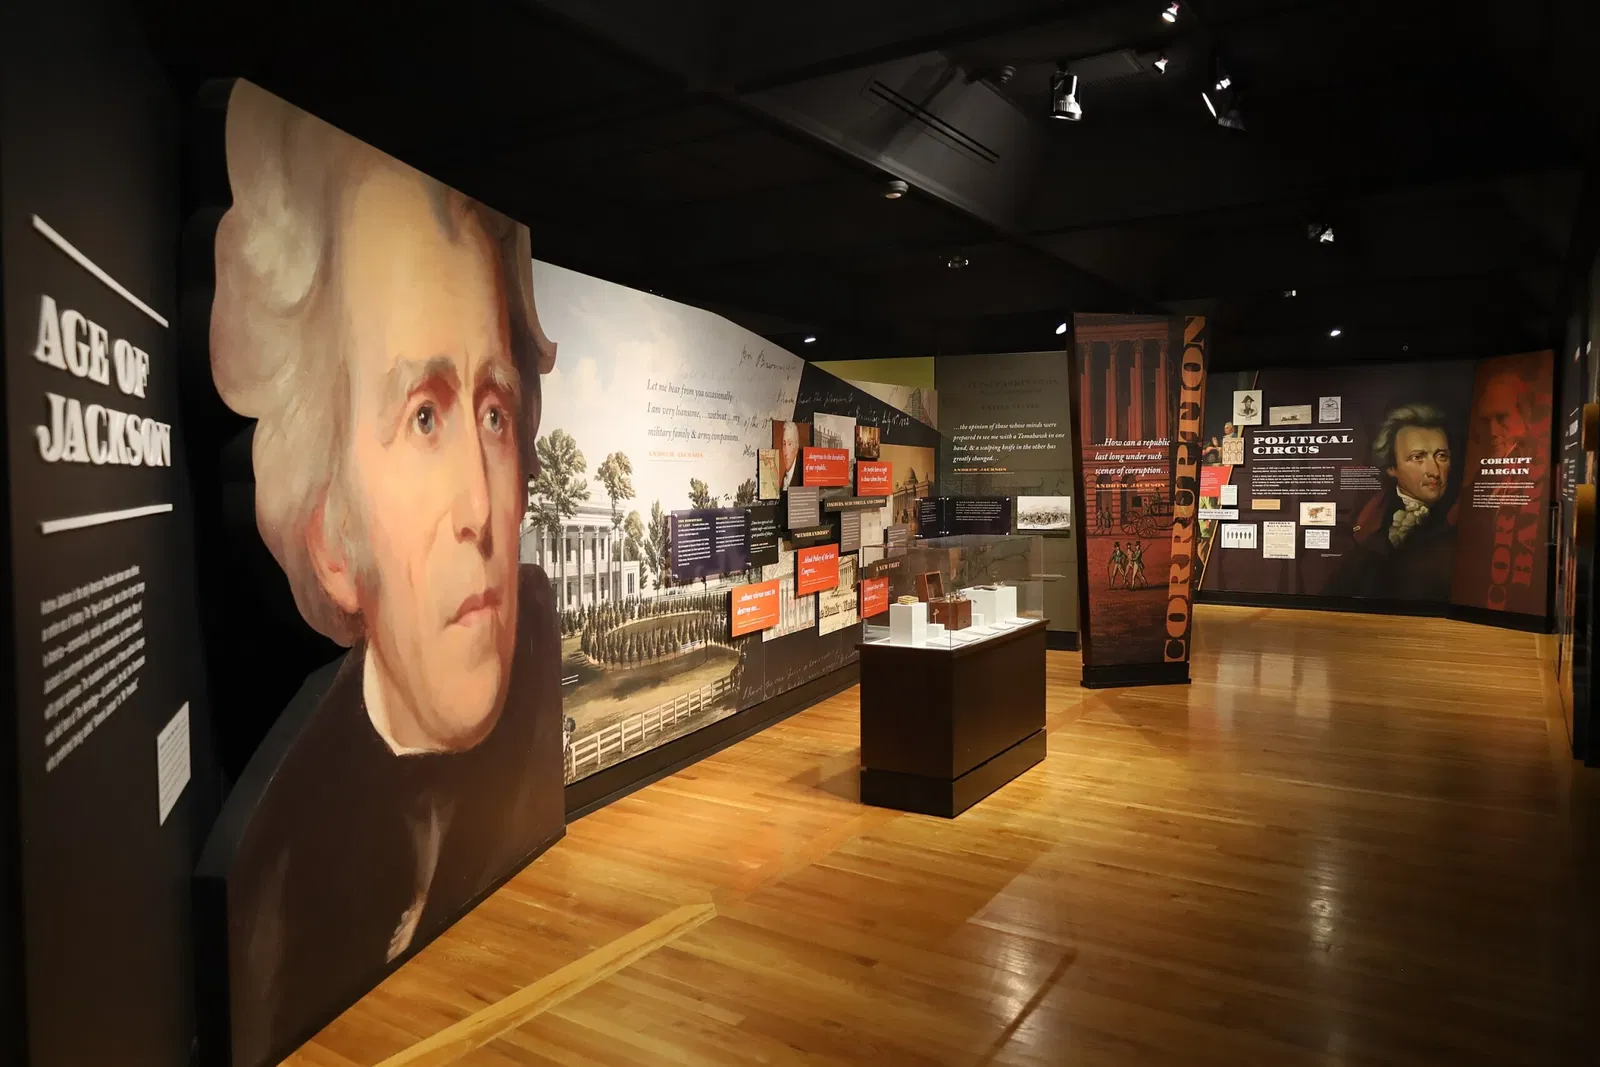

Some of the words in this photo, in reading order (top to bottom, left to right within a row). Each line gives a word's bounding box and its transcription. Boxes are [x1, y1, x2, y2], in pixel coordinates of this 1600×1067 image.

[33, 294, 110, 385] AGE
[113, 338, 149, 399] OF
[646, 379, 658, 391] Let
[659, 384, 669, 393] me
[668, 382, 681, 394] hear
[680, 384, 695, 398] from
[695, 389, 706, 400] you
[647, 402, 651, 413] I
[662, 407, 675, 419] very
[35, 392, 171, 468] JACKSON
[968, 424, 989, 432] opinion
[989, 422, 997, 432] of
[1009, 422, 1026, 430] whose
[1026, 421, 1043, 429] minds
[648, 426, 673, 441] military
[671, 427, 691, 442] family
[690, 430, 697, 439] &
[697, 433, 711, 443] army
[953, 434, 976, 442] prepared
[1017, 432, 1048, 440] Tomahawk
[1253, 435, 1354, 445] POLITICAL
[953, 444, 968, 452] hand,
[979, 445, 1001, 454] scalping
[1001, 443, 1016, 453] knife
[1143, 438, 1171, 449] republic
[1253, 446, 1320, 455] CIRCUS
[952, 455, 972, 464] greatly
[1095, 452, 1108, 460] last
[1109, 452, 1125, 463] long
[1126, 452, 1146, 460] under
[1147, 452, 1163, 460] such
[1480, 457, 1532, 465] CORRUPT
[1117, 466, 1126, 477] of
[1481, 467, 1530, 475] BARGAIN
[1164, 315, 1206, 663] CORRUPTION
